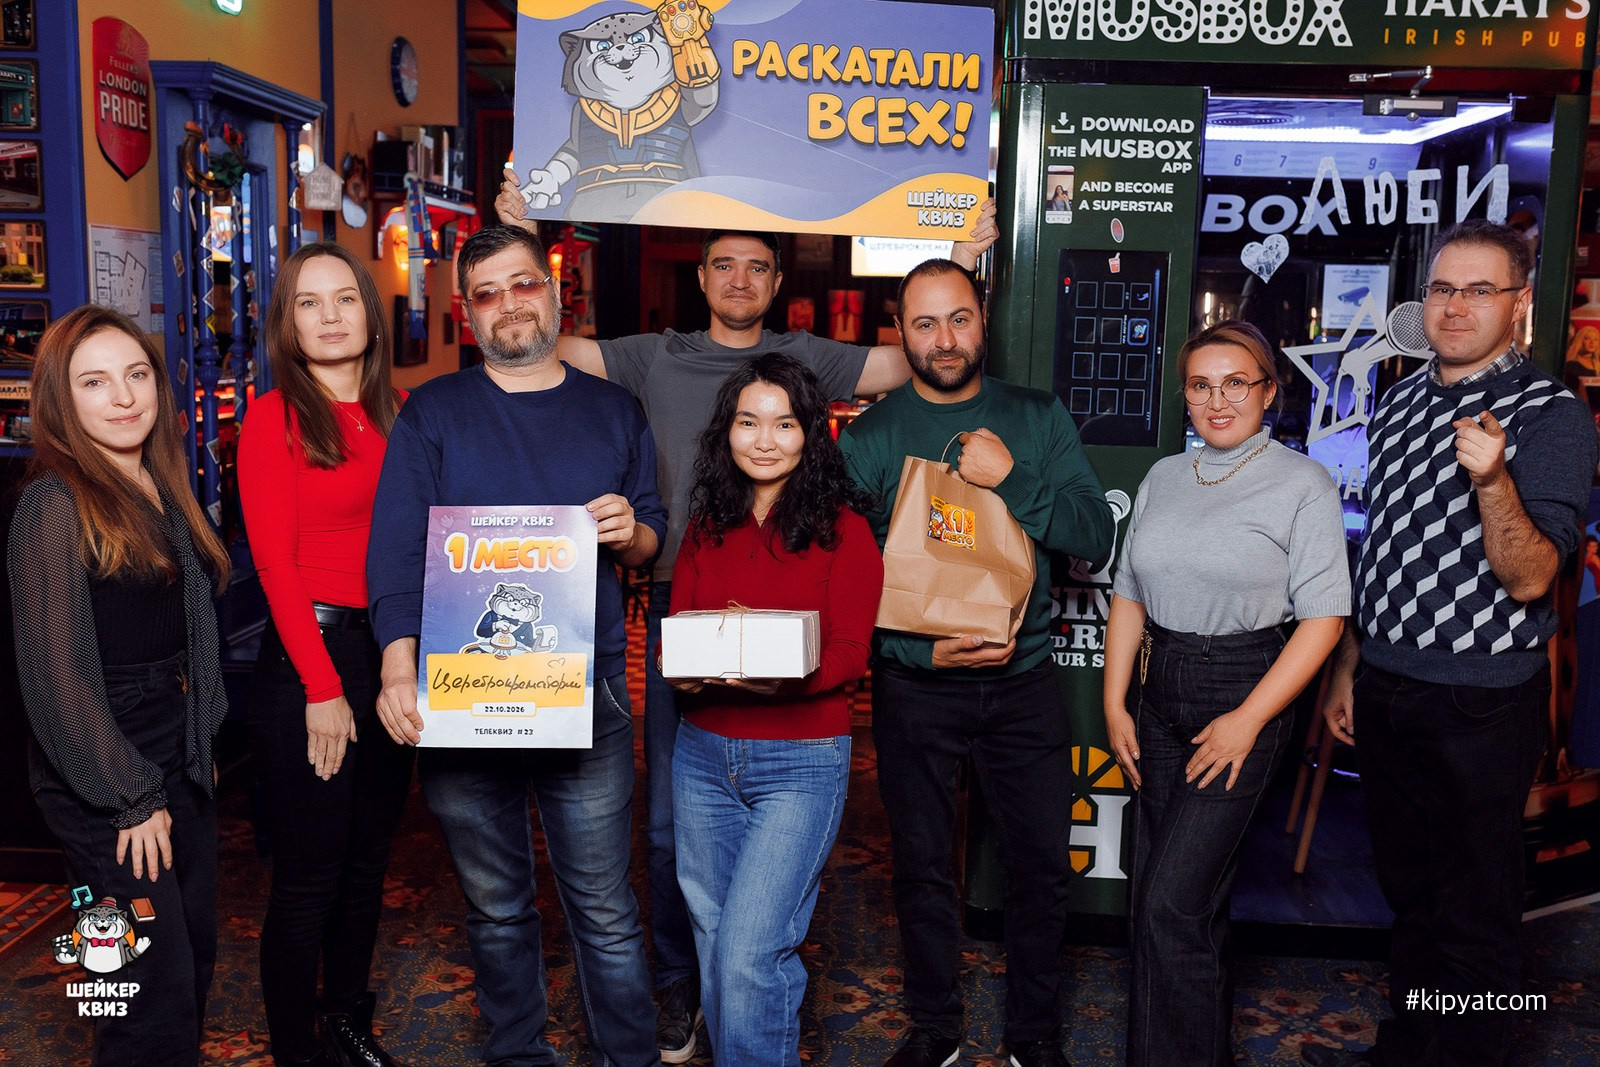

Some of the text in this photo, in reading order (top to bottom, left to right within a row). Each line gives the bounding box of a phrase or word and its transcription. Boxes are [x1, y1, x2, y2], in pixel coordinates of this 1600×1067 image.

[1024, 0, 1353, 46] MUSBOX
[1384, 28, 1586, 48] IRISH PUB
[732, 39, 981, 91] РАСКАТАЛИ
[99, 69, 148, 97] LONDON
[101, 90, 149, 131] PRIDE
[807, 92, 974, 150] ВСЕХ!
[1081, 116, 1196, 134] DOWNLOAD
[1047, 146, 1077, 158] THE
[1080, 138, 1194, 160] MUSBOX
[1161, 162, 1193, 174] APP
[1233, 154, 1243, 167] 6
[1278, 155, 1288, 168] 7
[1368, 157, 1378, 170] 9
[1080, 181, 1174, 194] AND BECOME
[906, 188, 979, 210] ШЕЙКЕР
[1078, 200, 1173, 213] A SUPERSTAR
[917, 209, 966, 228] КВИЗ
[1200, 193, 1340, 236] BOX
[471, 515, 554, 527] ШЕЙКЕР КВИЗ
[447, 534, 576, 570] 1 МЕСТО
[484, 705, 525, 713] 22.10.2026
